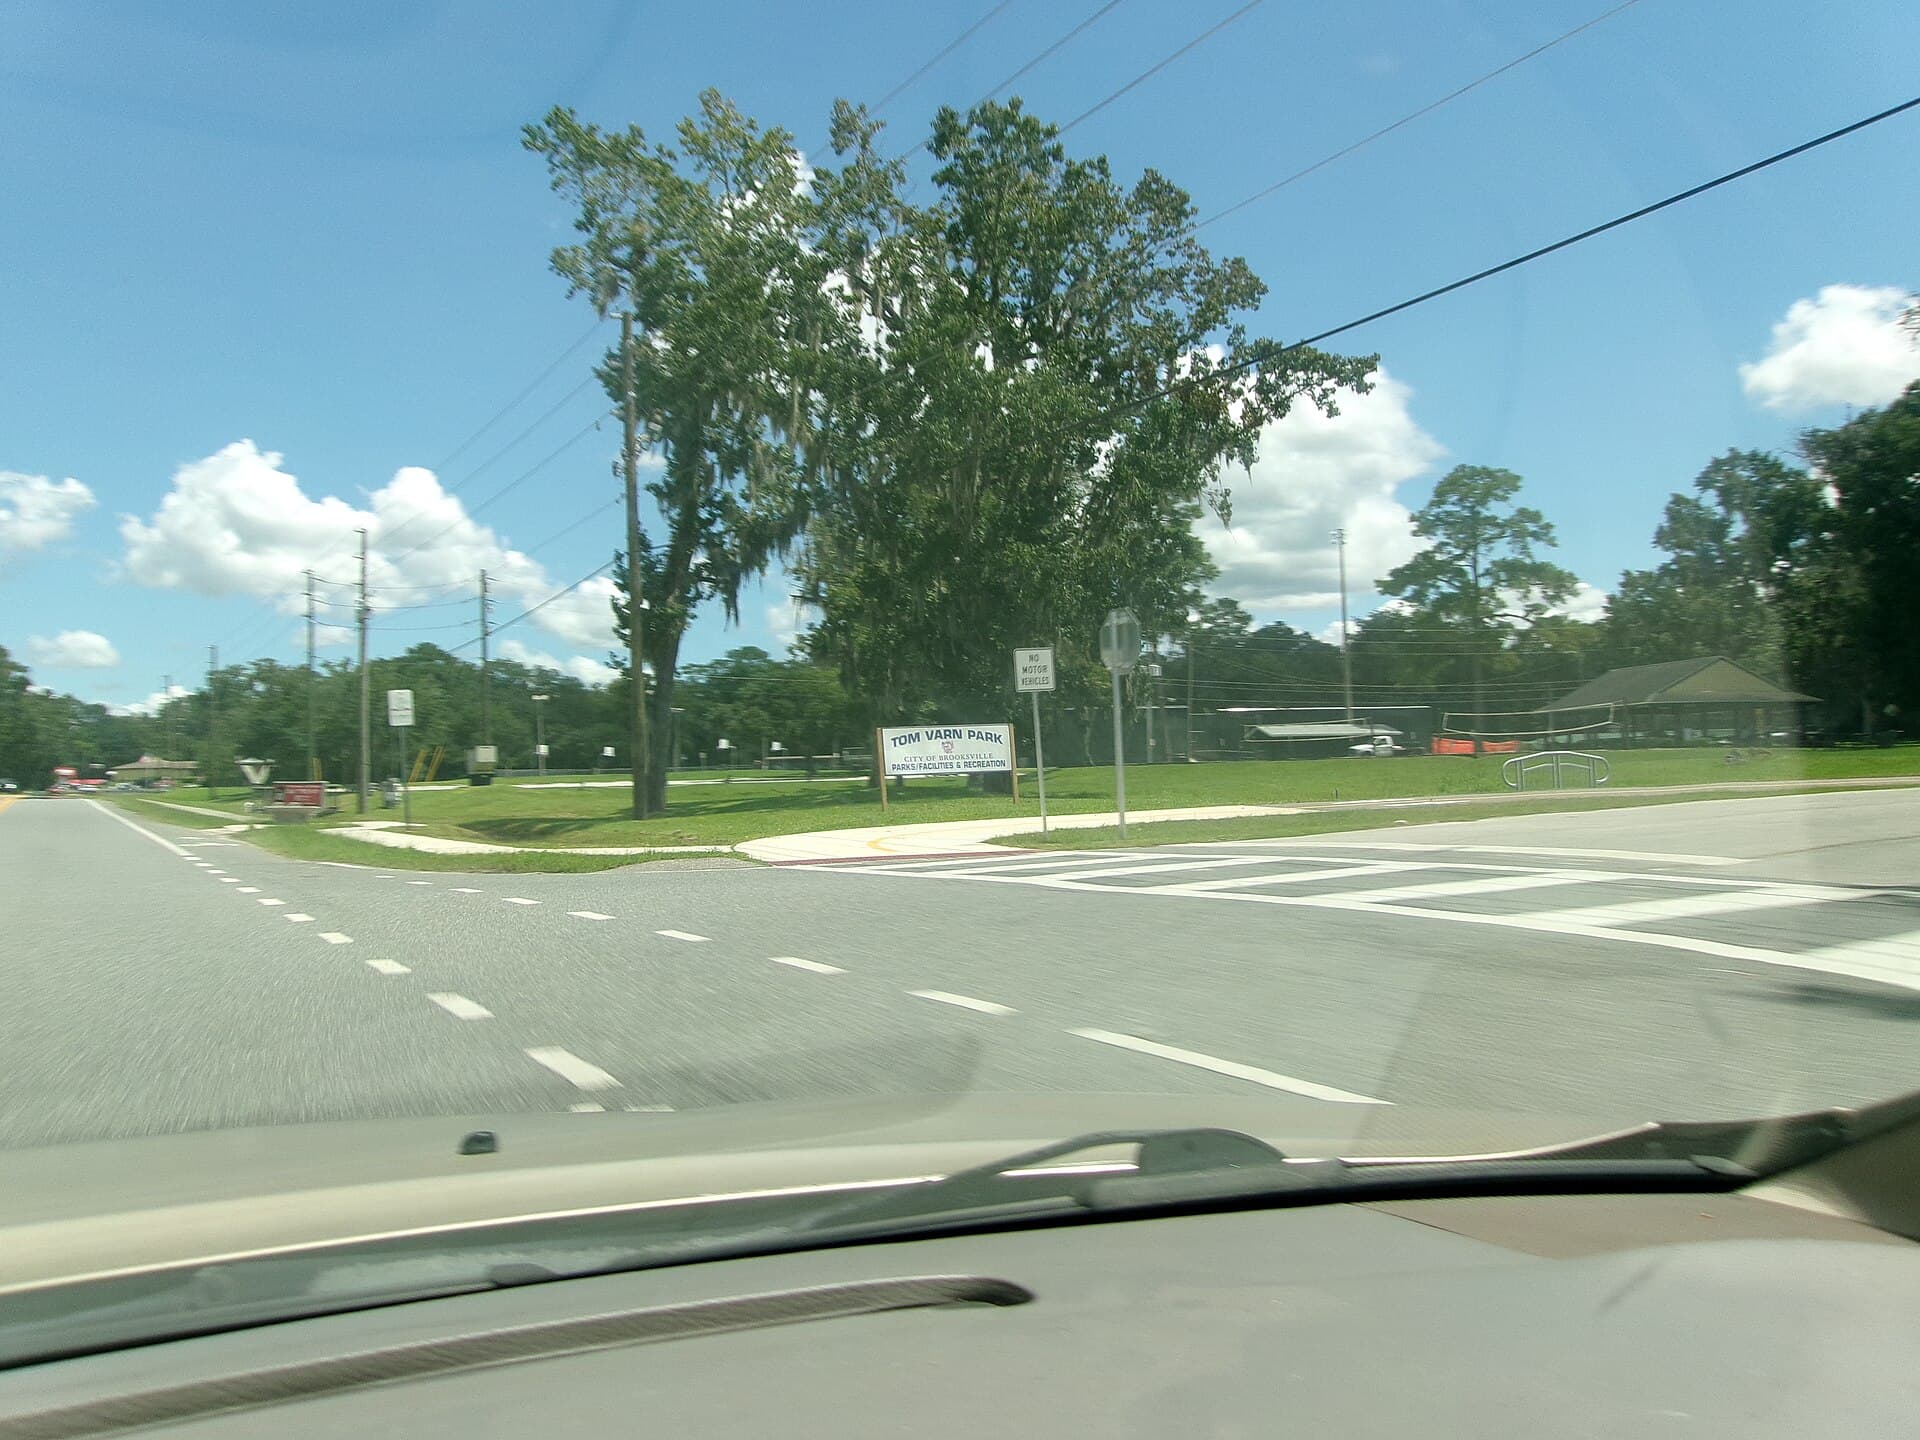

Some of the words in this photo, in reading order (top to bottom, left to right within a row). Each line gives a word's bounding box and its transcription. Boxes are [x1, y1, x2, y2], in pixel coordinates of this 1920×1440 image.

[1028, 654, 1040, 662] NO
[1022, 664, 1048, 673] MOTOR
[1021, 676, 1049, 685] VEHICLES
[891, 732, 920, 747] TOM
[925, 729, 962, 740] VARN
[968, 730, 1003, 744] PARK
[939, 753, 994, 761] BROOKSVILLE
[891, 762, 954, 771] PARKS/FACILITIES
[963, 760, 1006, 769] RECREATION
